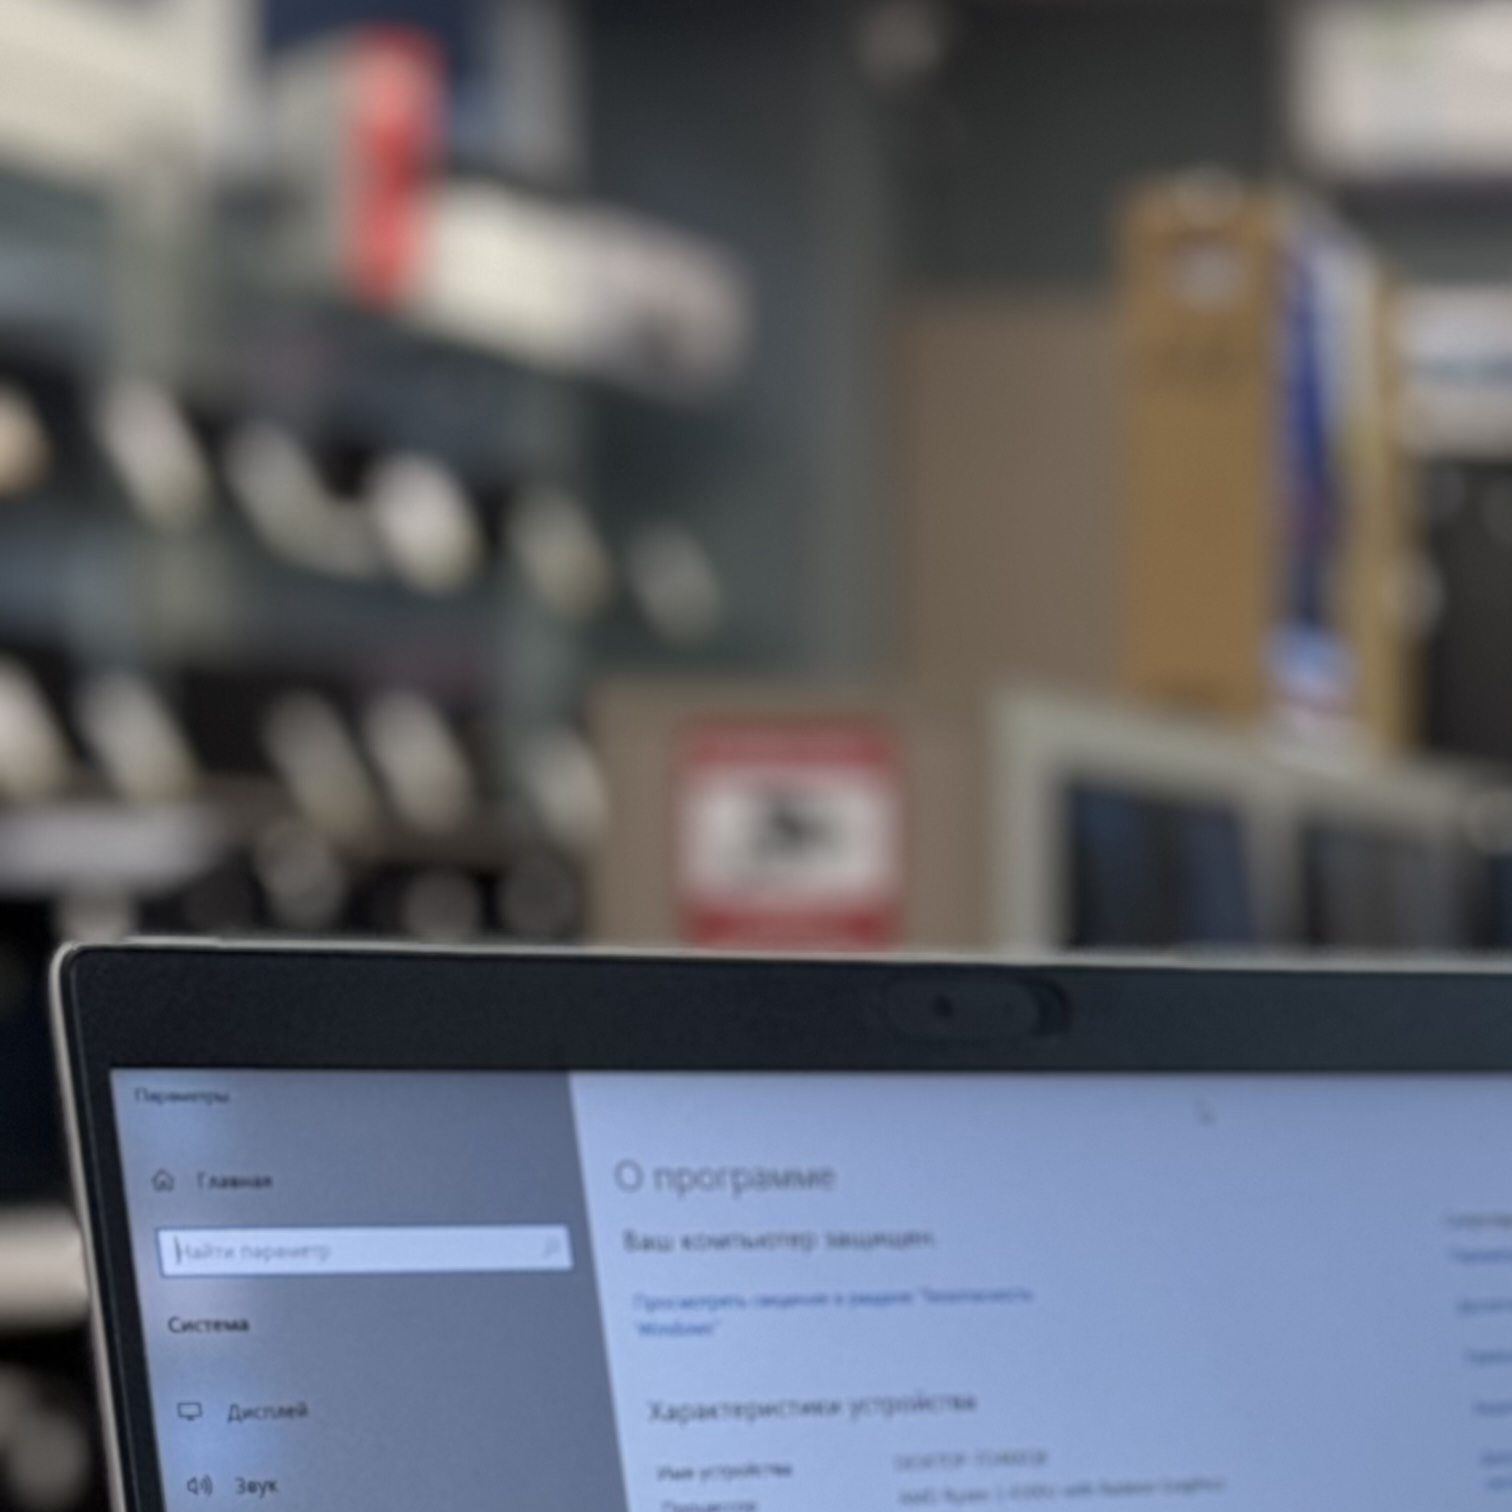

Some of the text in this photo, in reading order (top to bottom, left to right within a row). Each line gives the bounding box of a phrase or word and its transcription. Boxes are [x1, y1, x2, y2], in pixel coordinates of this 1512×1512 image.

[134, 1087, 230, 1105] Параметры
[197, 1172, 273, 1190] Главная
[614, 1158, 836, 1198] О программе
[623, 1228, 674, 1252] Ваш
[681, 1229, 817, 1255] компьютер
[178, 1242, 332, 1263] Найти параметр
[167, 1316, 250, 1334] Система
[227, 1402, 309, 1423] Дисплей
[648, 1389, 978, 1427] Характеристики устройства
[234, 1476, 278, 1499] Звук
